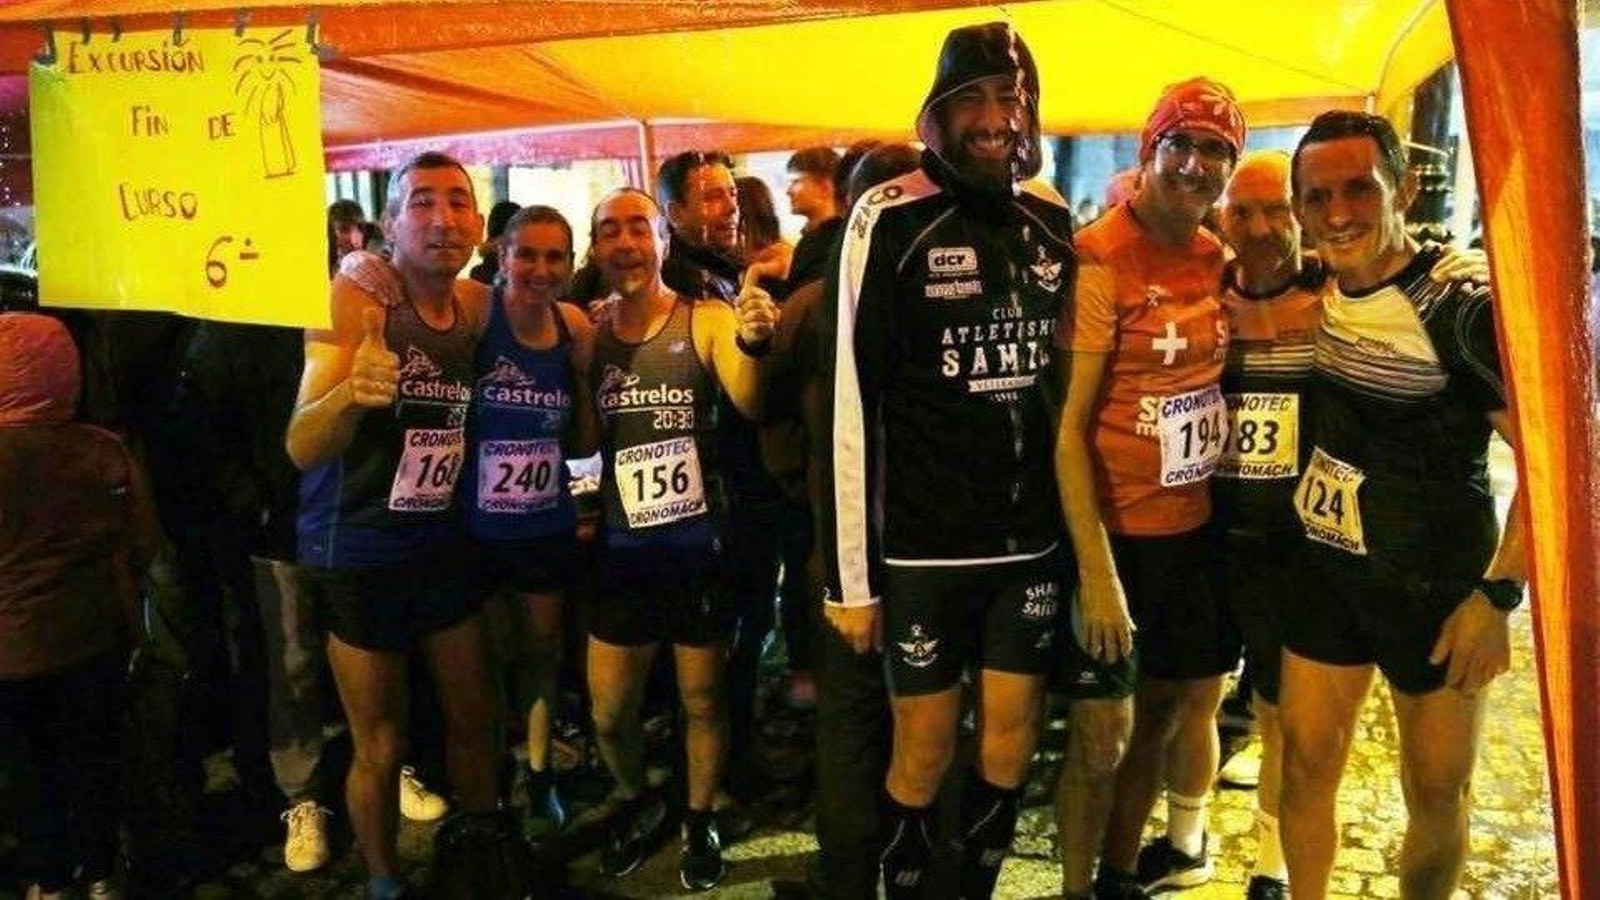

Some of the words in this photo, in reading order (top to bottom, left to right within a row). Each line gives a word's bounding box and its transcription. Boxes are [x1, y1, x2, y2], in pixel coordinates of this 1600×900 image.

[131, 104, 169, 137] FIN
[207, 113, 236, 140] DE
[119, 182, 198, 221] CURSO
[941, 318, 1056, 345] ATLETISM
[1180, 410, 1222, 459] 194
[617, 441, 692, 466] CRONOTEC
[492, 460, 551, 494] 240
[632, 461, 689, 502] 156
